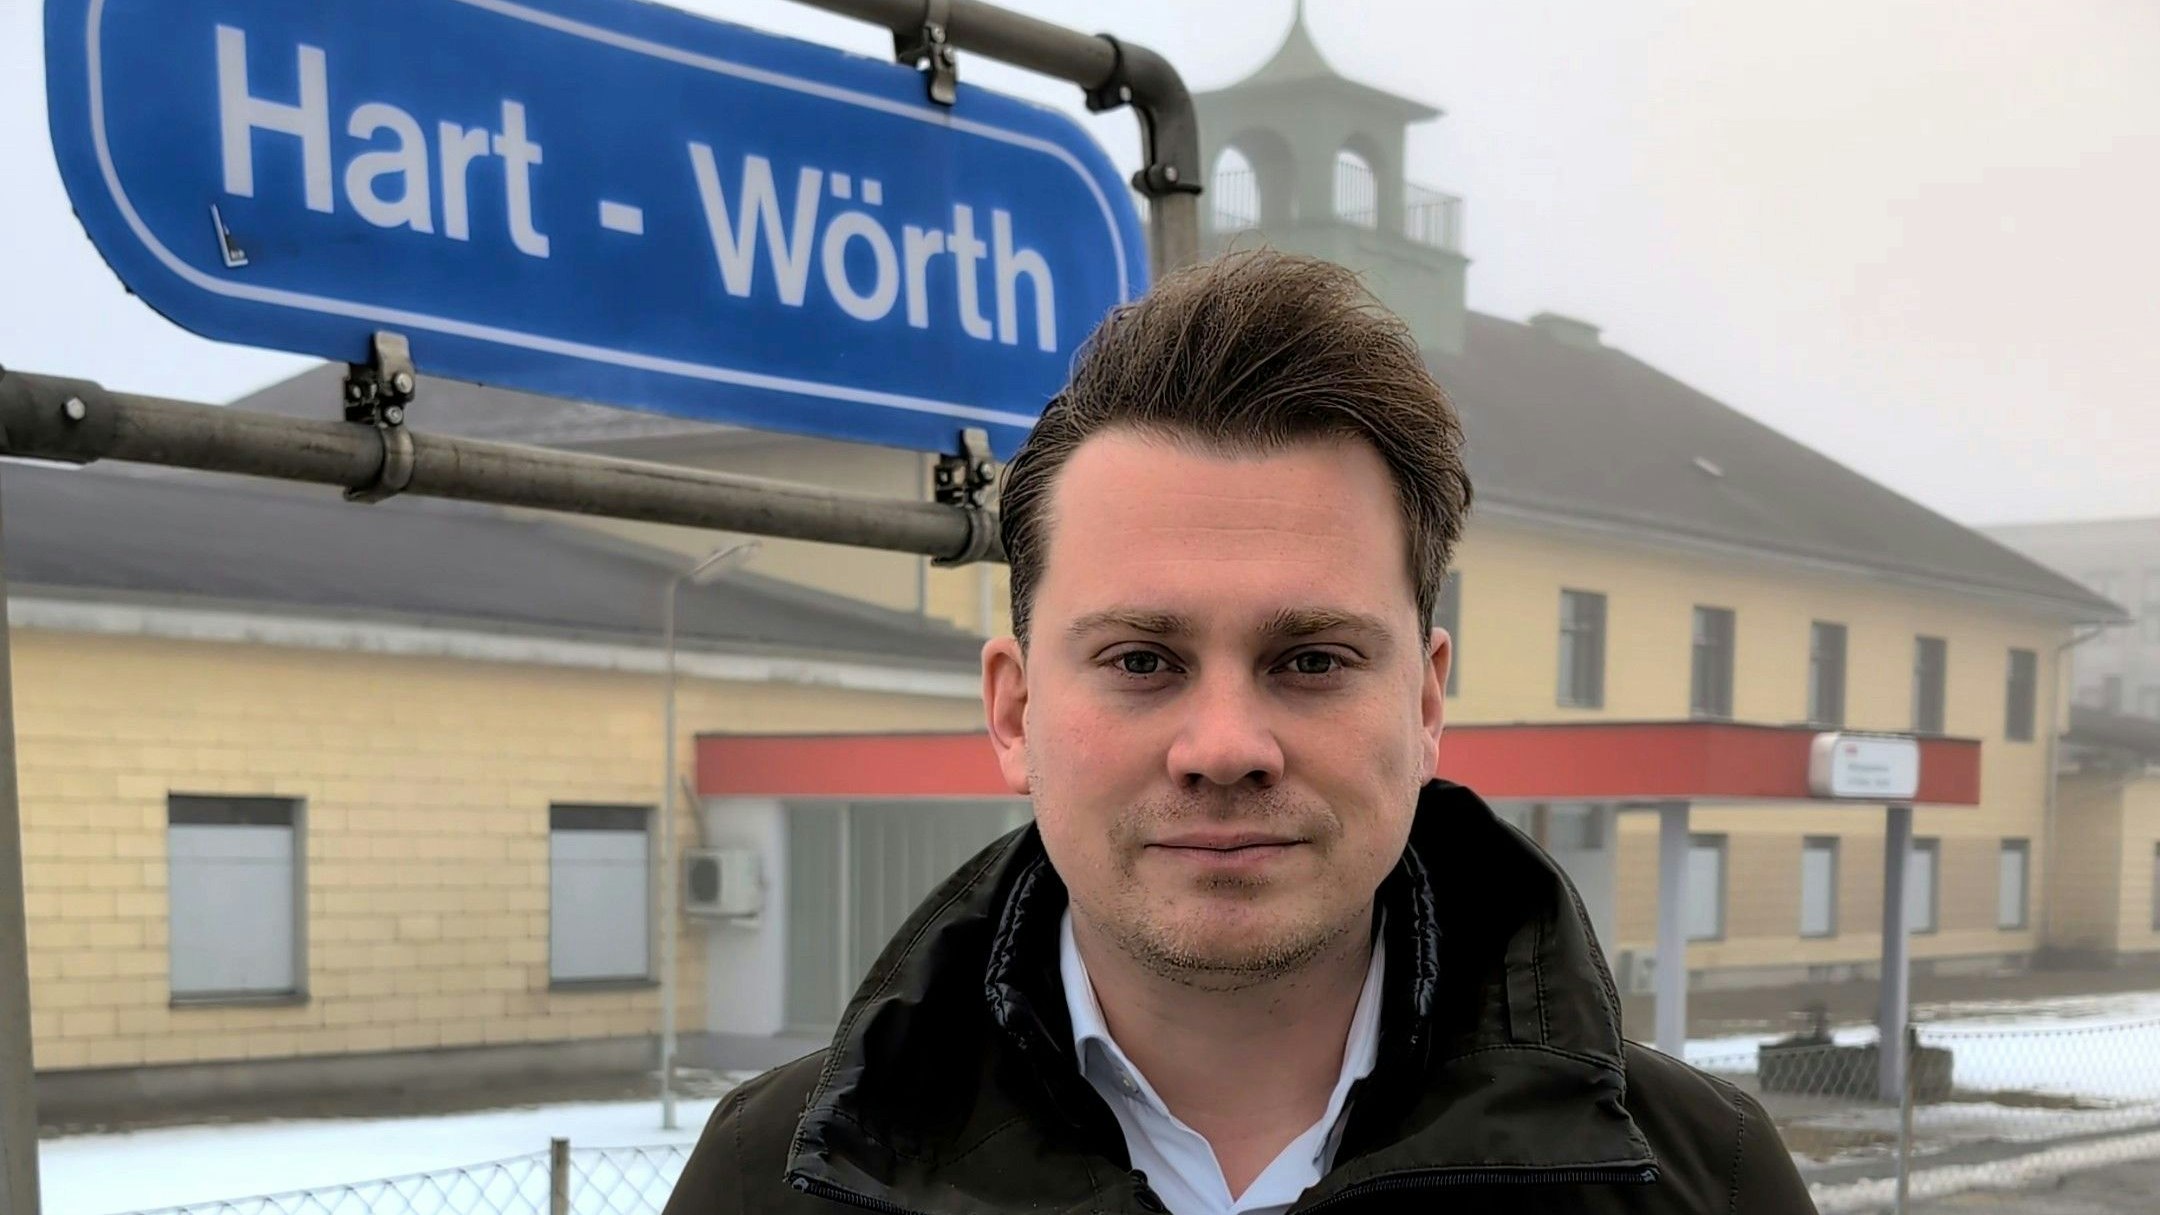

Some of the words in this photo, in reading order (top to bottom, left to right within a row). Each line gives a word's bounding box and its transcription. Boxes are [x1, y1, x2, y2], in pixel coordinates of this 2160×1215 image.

[217, 25, 549, 257] Hart
[600, 200, 643, 233] -
[690, 143, 1057, 352] Wörth
